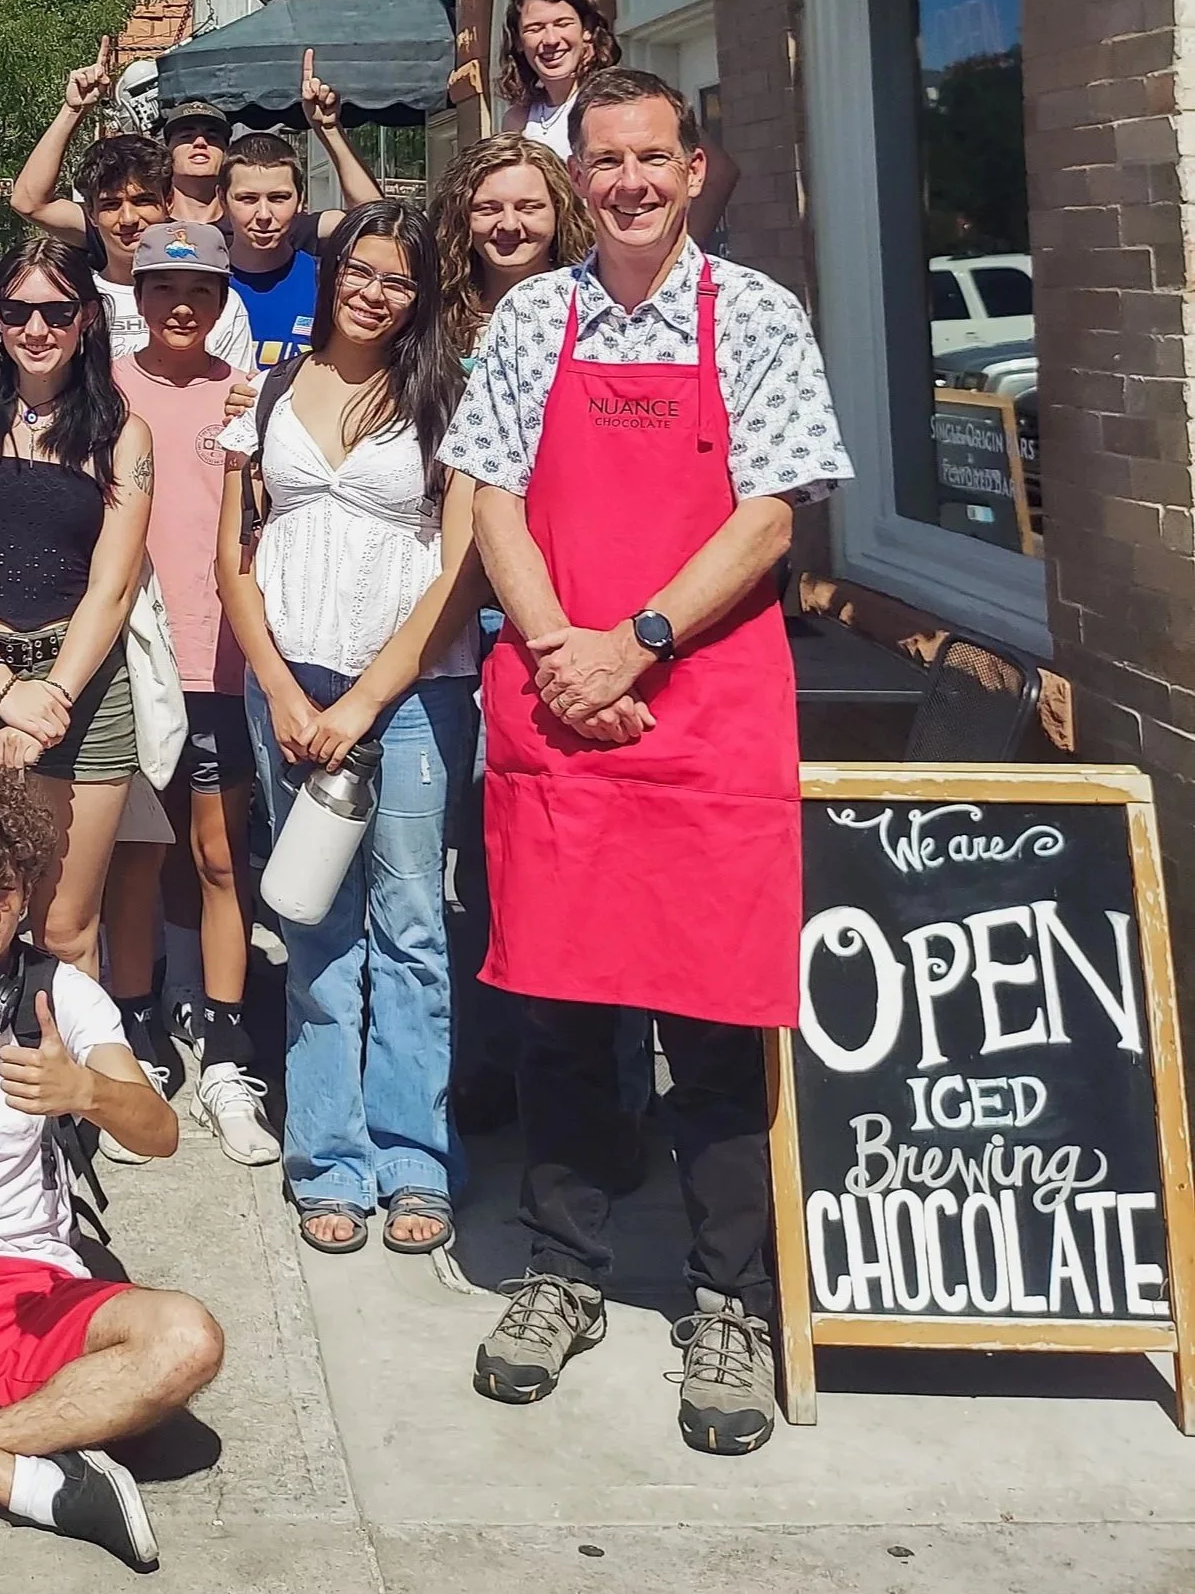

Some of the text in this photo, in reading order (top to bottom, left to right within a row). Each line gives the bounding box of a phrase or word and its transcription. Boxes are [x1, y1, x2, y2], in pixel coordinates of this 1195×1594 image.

[589, 398, 679, 417] NUANCE
[595, 417, 671, 429] CHOCOLATE
[947, 824, 1065, 863] are
[799, 900, 1144, 1073] OPEN
[906, 1075, 1048, 1131] ICED
[846, 1113, 1108, 1212] Brewing
[806, 1190, 1170, 1315] CHOCOLATE
